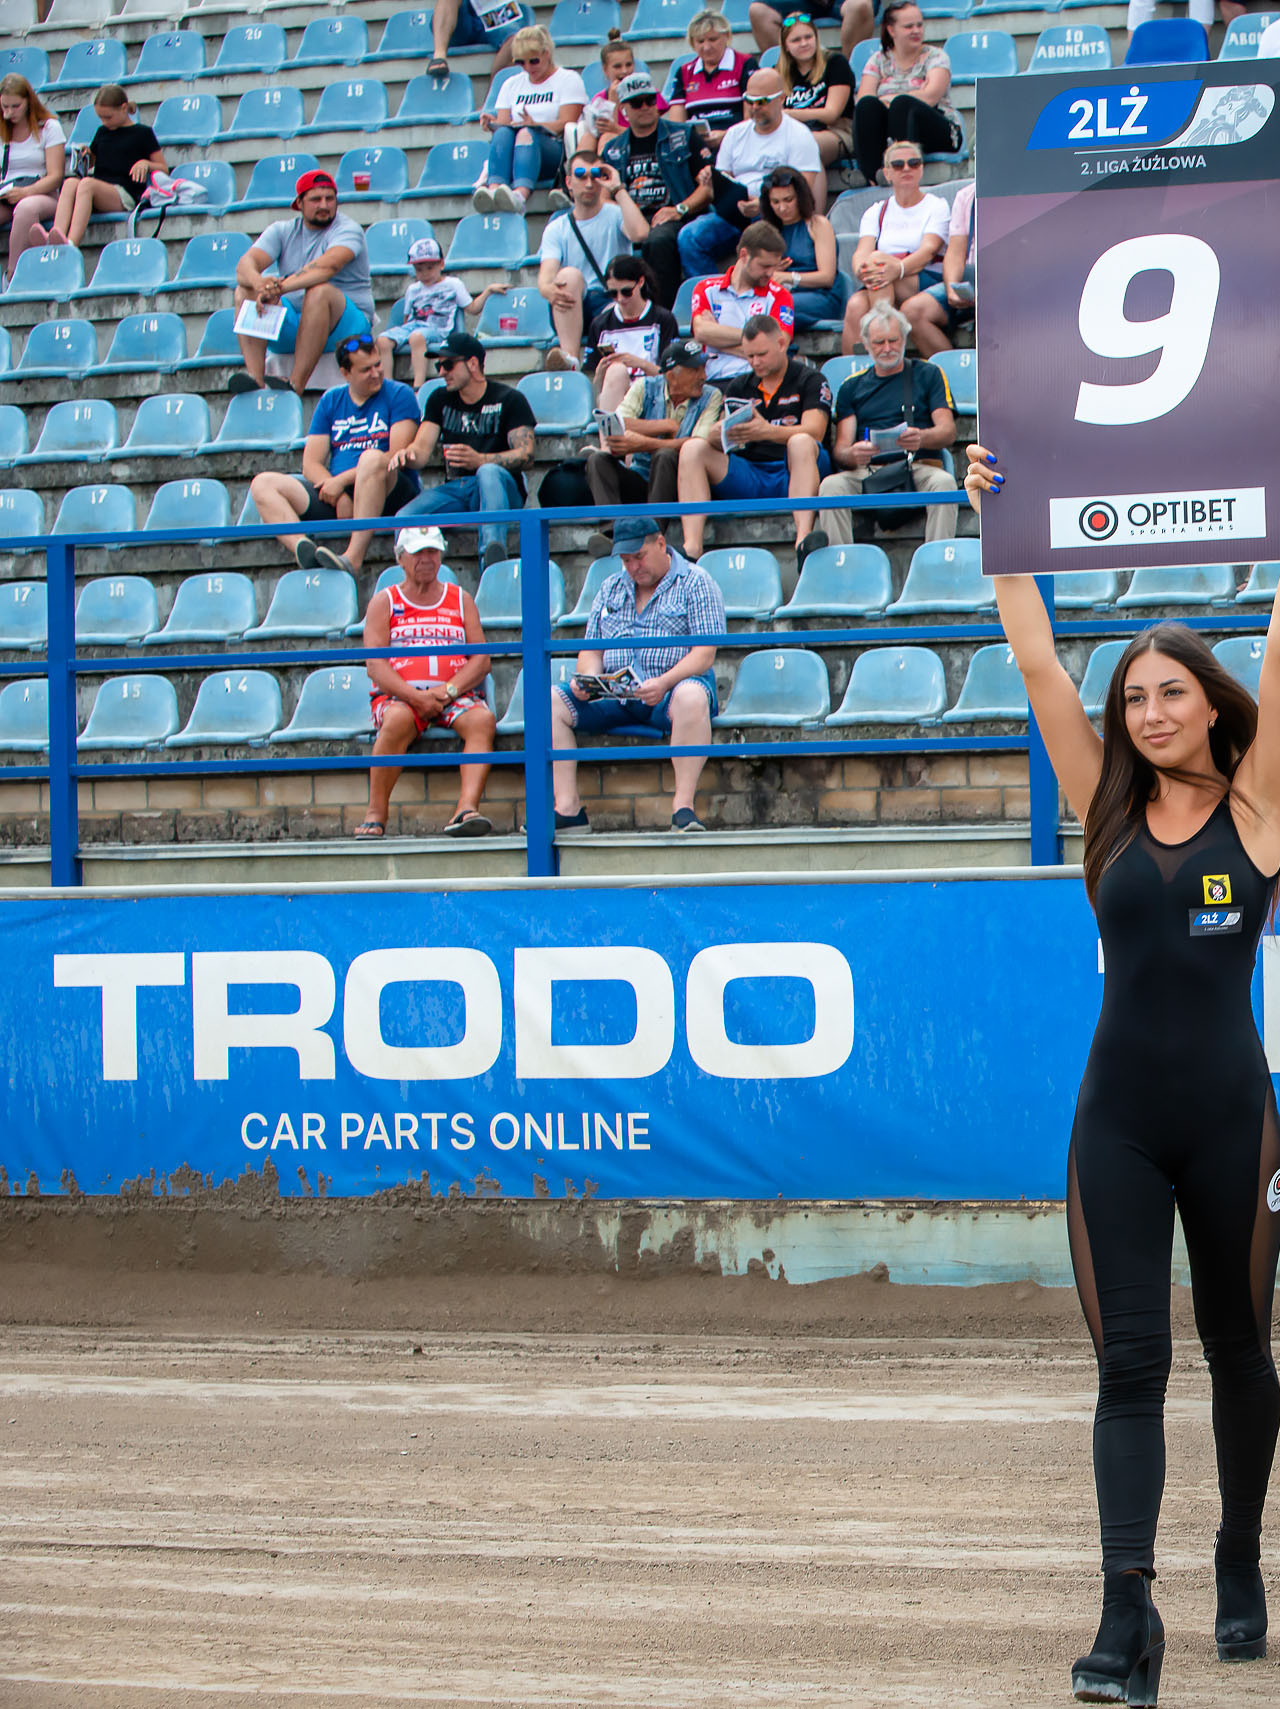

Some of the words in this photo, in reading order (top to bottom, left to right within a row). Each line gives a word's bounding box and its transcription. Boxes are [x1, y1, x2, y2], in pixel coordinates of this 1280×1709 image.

[971, 35, 988, 48] 11
[1065, 29, 1083, 43] 10
[432, 78, 450, 91] 17
[1068, 86, 1149, 140] 2LŻ
[1081, 161, 1093, 175] 2.
[1096, 159, 1130, 174] LIGA
[1132, 154, 1207, 173] ŻUŻLOWA
[1074, 233, 1221, 426] 9
[544, 377, 563, 391] 13
[165, 400, 184, 415] 17
[91, 489, 108, 505] 17
[1127, 498, 1236, 527] OPTIBET
[944, 546, 955, 562] 8
[14, 587, 32, 602] 17
[54, 942, 855, 1081] TRODO
[241, 1113, 325, 1151] CAR
[341, 1113, 475, 1151] PARTS
[490, 1113, 651, 1151] ONLINE
